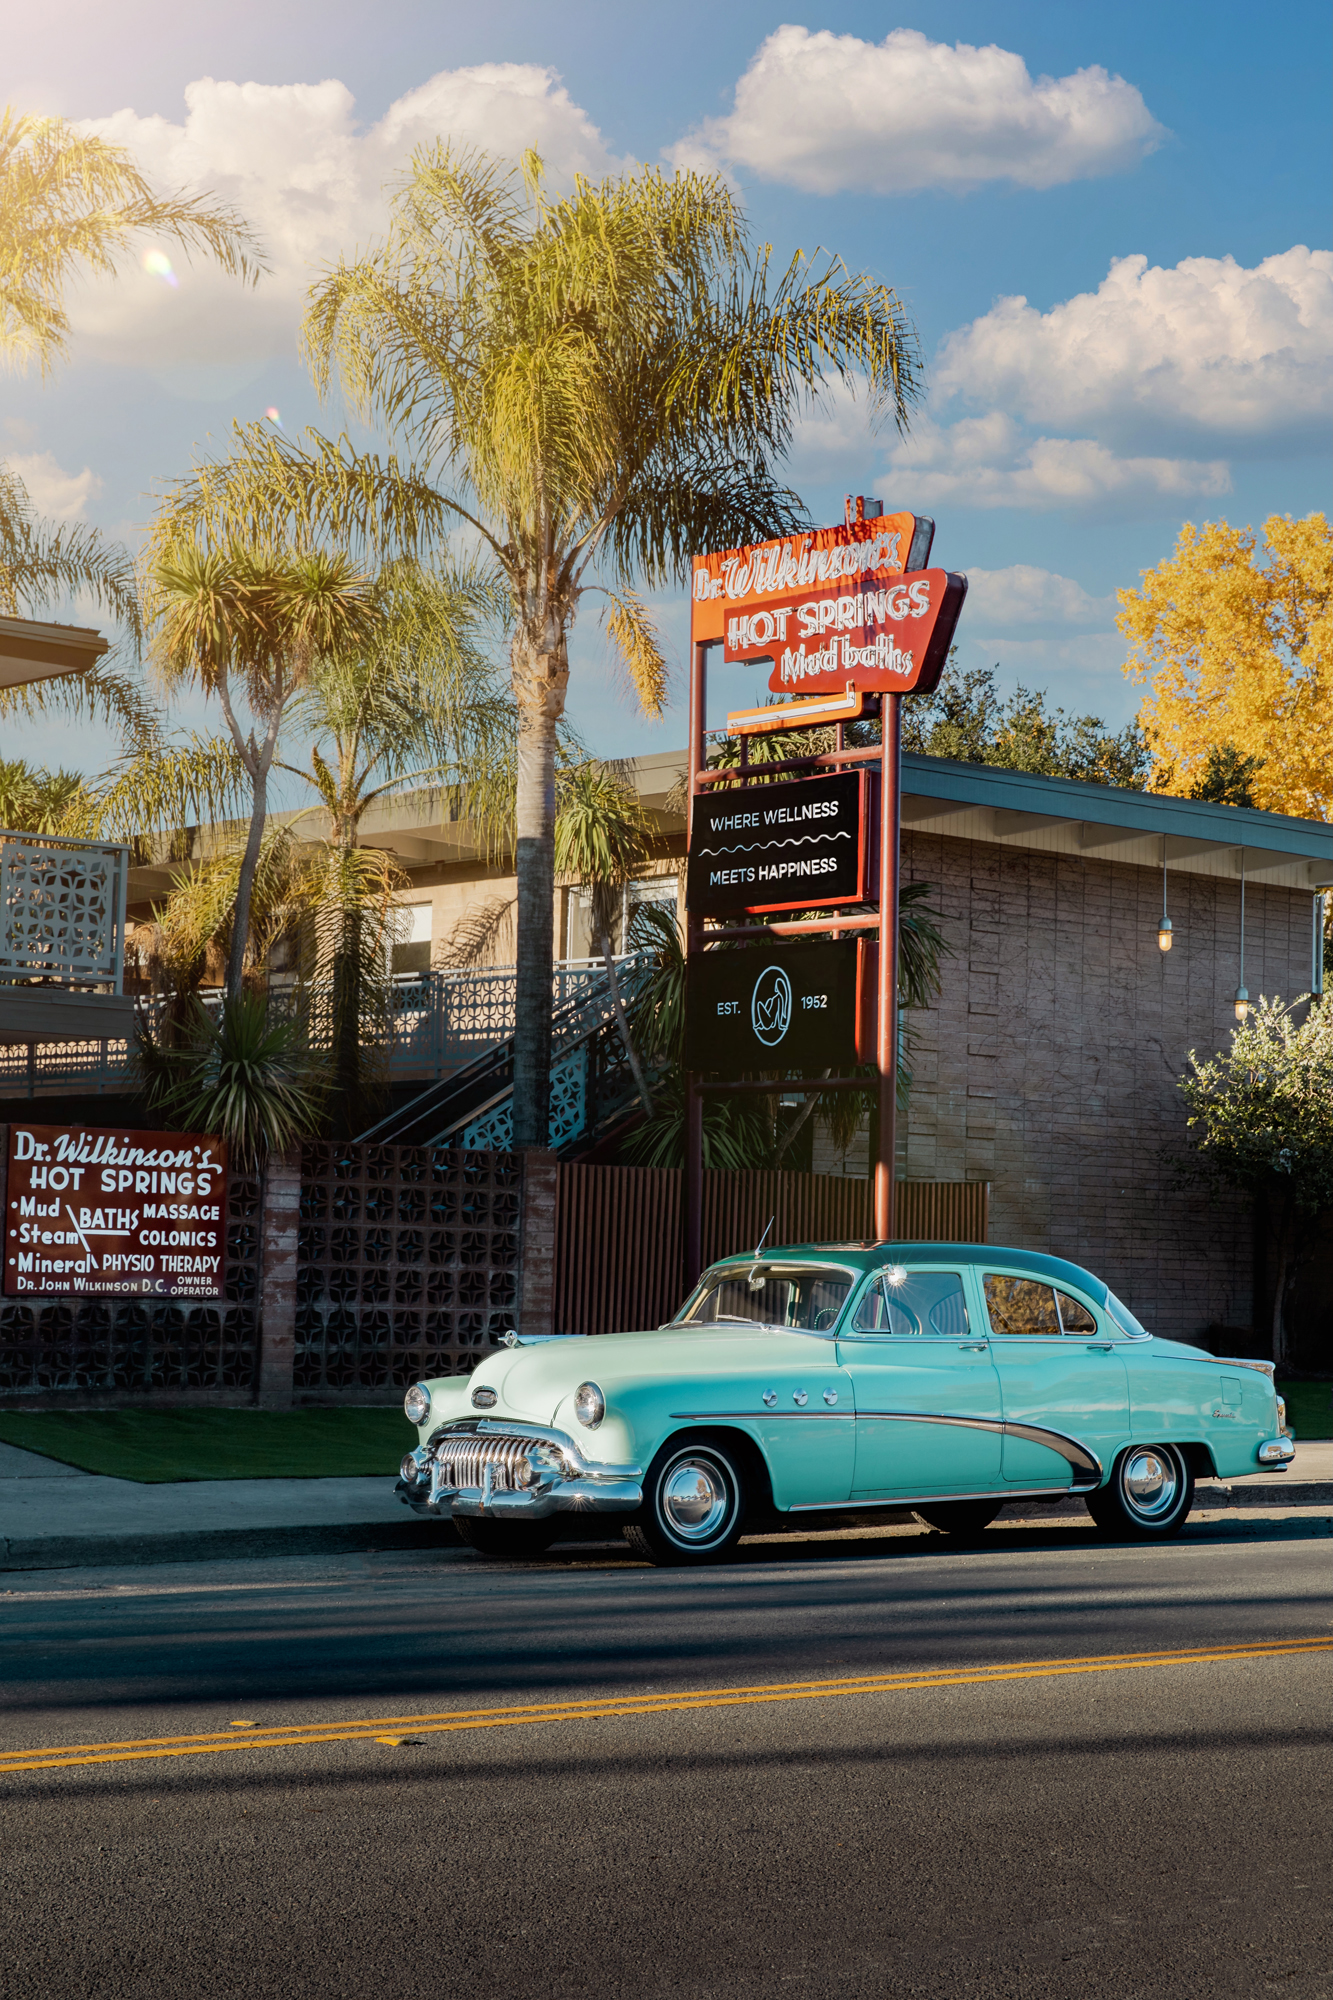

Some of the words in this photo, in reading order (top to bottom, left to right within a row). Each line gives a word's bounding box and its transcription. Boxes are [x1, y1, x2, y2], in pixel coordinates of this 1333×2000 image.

[693, 568, 725, 602] Dr.
[721, 532, 902, 600] Wilkinson's
[727, 606, 793, 651] HOT
[797, 580, 931, 639] SPRINGS
[780, 635, 838, 685] Mud
[710, 812, 760, 831] WHERE
[763, 800, 839, 824] WELLNESS
[710, 867, 755, 886] MEETS
[758, 857, 838, 881] HAPPINESS
[717, 1001, 741, 1015] EST.
[801, 994, 828, 1010] 1952
[14, 1131, 51, 1162] Dr.
[53, 1132, 223, 1175] Wilkinson's
[30, 1166, 85, 1190] HOT
[101, 1168, 212, 1196] SPRINGS
[20, 1195, 60, 1218] Mud
[143, 1203, 220, 1221] MASSAGE
[79, 1207, 140, 1230] BATHS
[19, 1222, 79, 1245] Steam
[139, 1229, 217, 1247] COLONICS
[17, 1251, 91, 1273] Mineral
[102, 1253, 155, 1272] PHYSIO
[159, 1254, 221, 1273] THERAPY
[141, 1278, 167, 1293] D.C.
[170, 1285, 219, 1296] OPERATOR
[177, 1275, 212, 1286] OWNER
